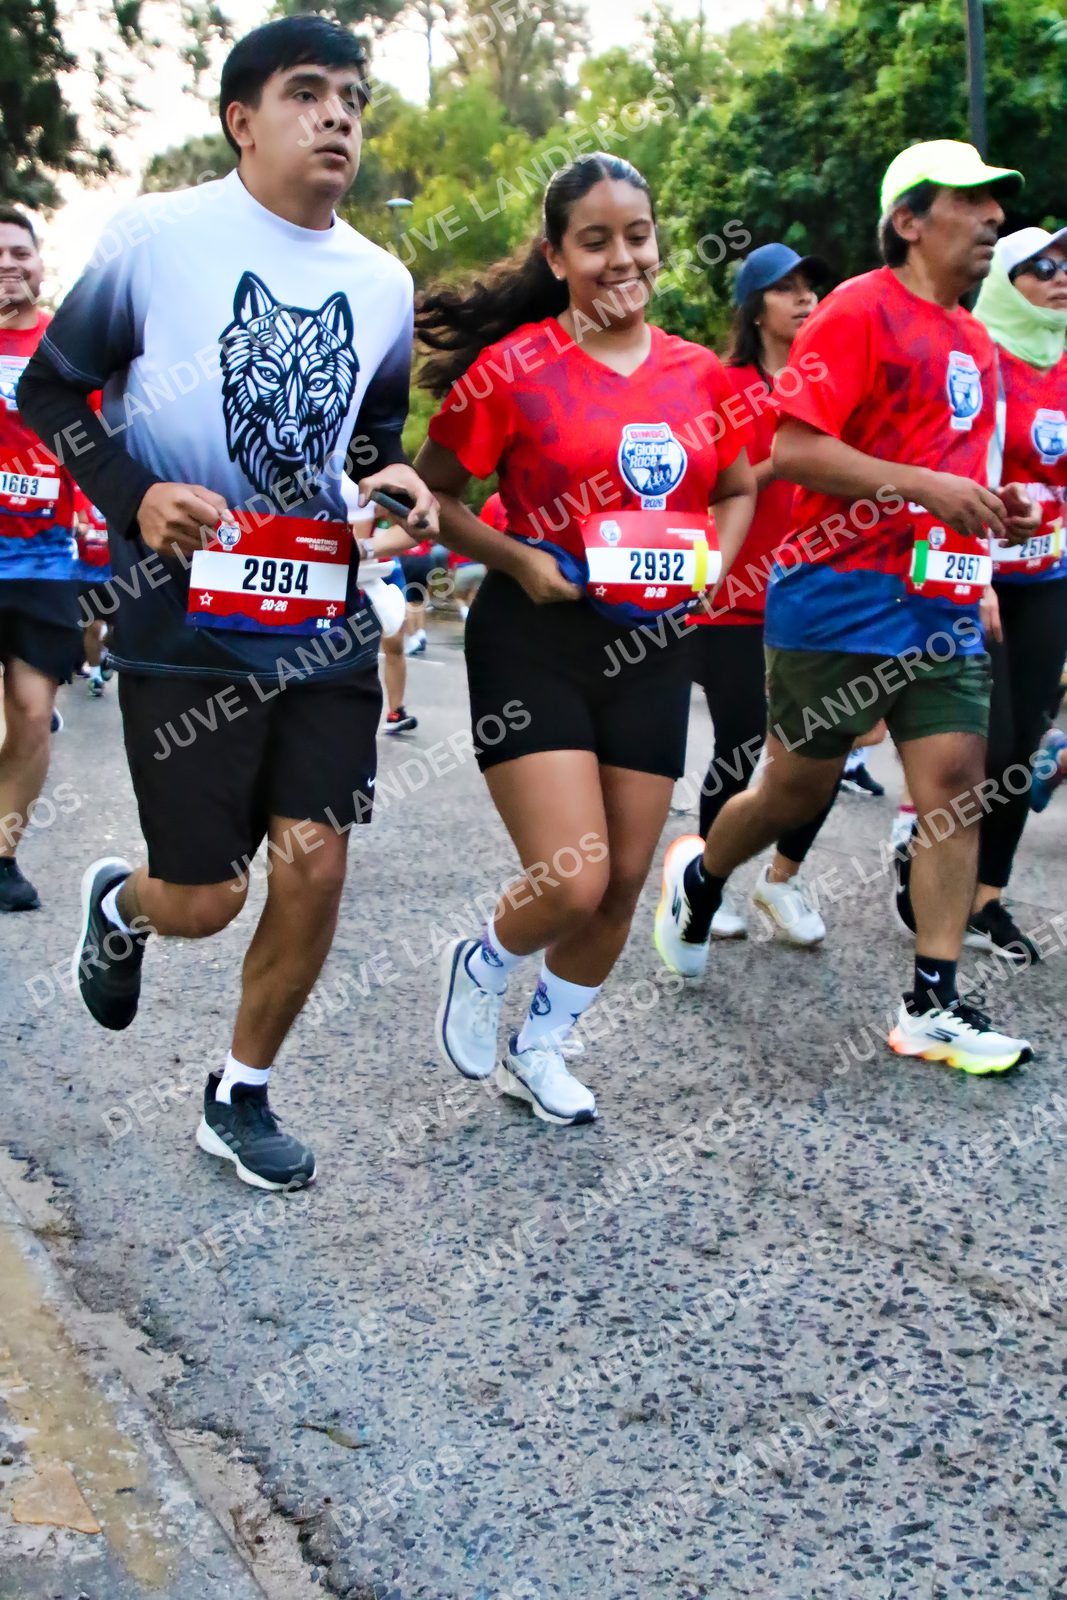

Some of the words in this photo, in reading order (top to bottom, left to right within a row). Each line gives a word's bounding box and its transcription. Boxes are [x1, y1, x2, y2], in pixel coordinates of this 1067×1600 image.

[630, 431, 666, 440] BIMBO
[635, 443, 669, 456] Global
[630, 455, 658, 468] Race
[2, 474, 39, 496] 1663
[630, 551, 685, 581] 2932
[242, 558, 309, 595] 2934
[260, 599, 289, 612] 20-26
[316, 619, 332, 629] 5K
